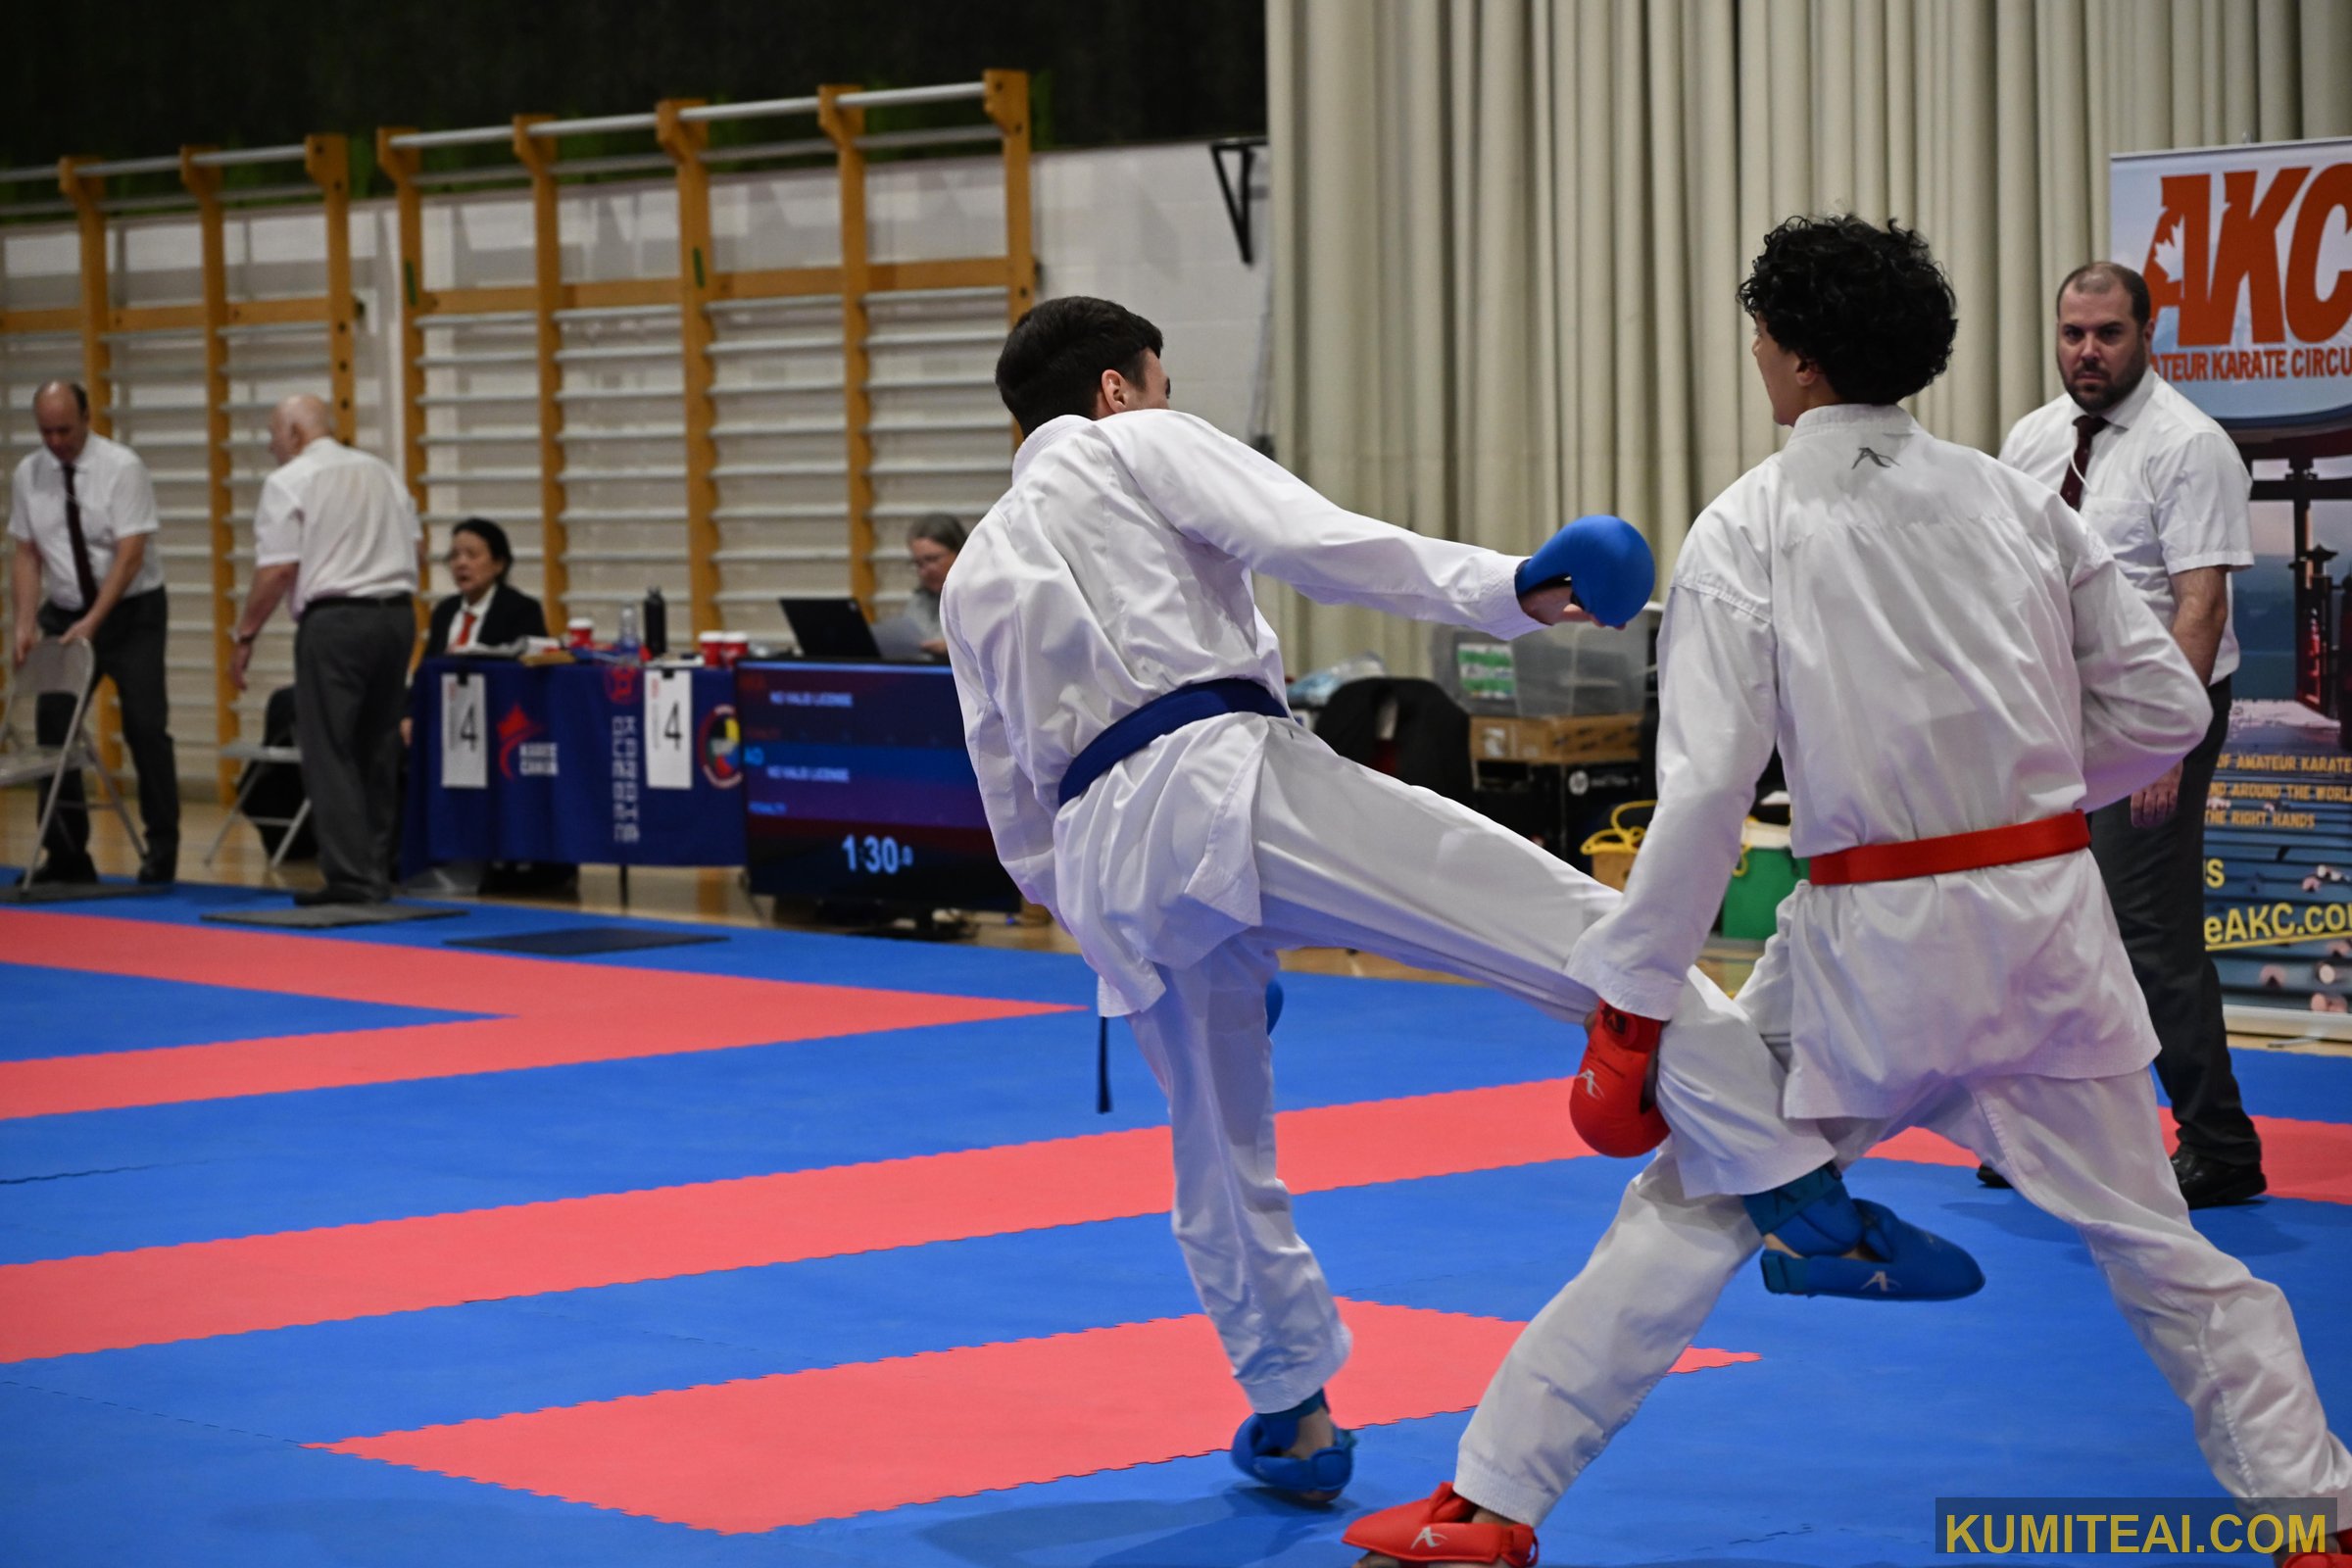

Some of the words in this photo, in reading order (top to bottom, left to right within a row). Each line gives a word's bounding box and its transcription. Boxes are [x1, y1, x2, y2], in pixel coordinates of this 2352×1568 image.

[2143, 163, 2352, 347] AKC
[2212, 350, 2287, 380] KARATE
[460, 703, 478, 752] 4
[664, 702, 682, 751] 4
[2236, 754, 2297, 771] AMATEUR
[2300, 757, 2352, 774] KARATE
[2230, 783, 2281, 799] AROUND
[2286, 784, 2311, 801] THE
[2316, 785, 2352, 803] WORL
[2231, 810, 2267, 827] RIGHT
[2272, 812, 2316, 829] HANDS
[2204, 858, 2226, 889] S
[2204, 902, 2352, 945] eAKC.co
